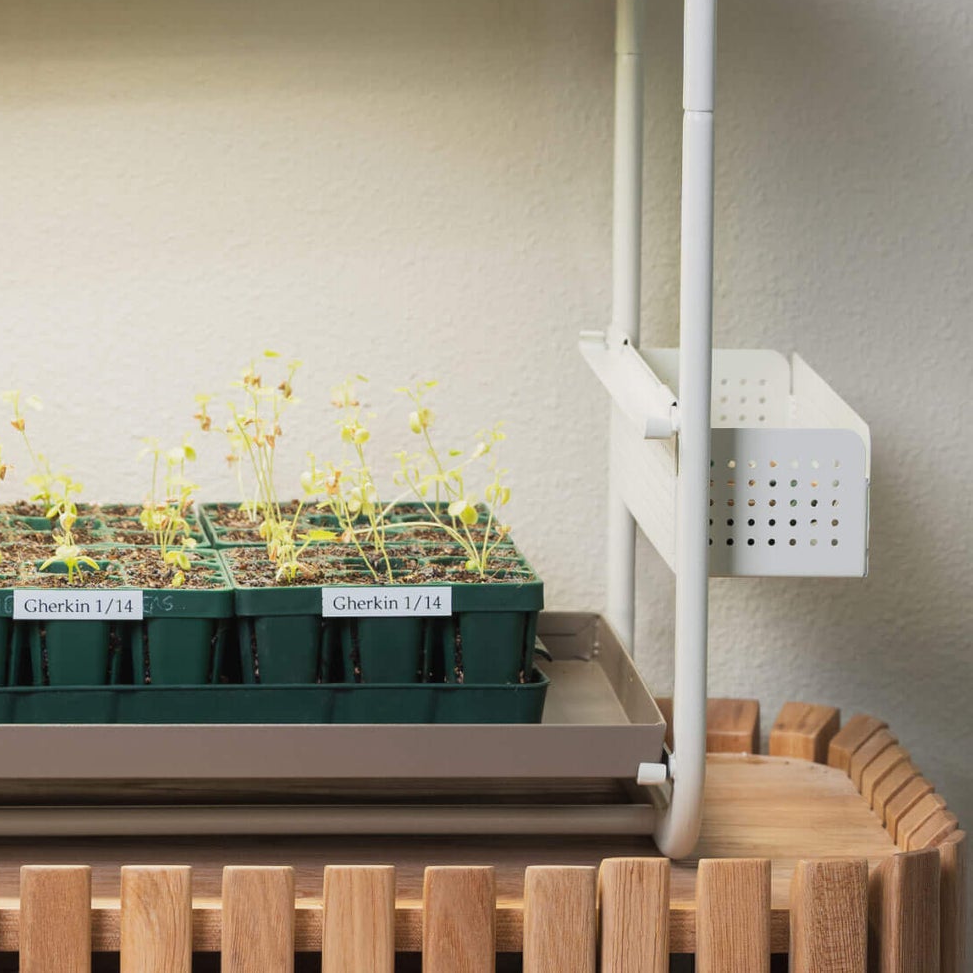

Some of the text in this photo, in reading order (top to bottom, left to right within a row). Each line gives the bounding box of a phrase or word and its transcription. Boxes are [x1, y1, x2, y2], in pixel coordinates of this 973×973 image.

[24, 598, 134, 615] Gherkin 1/14
[332, 595, 443, 612] Gherkin 1/14
